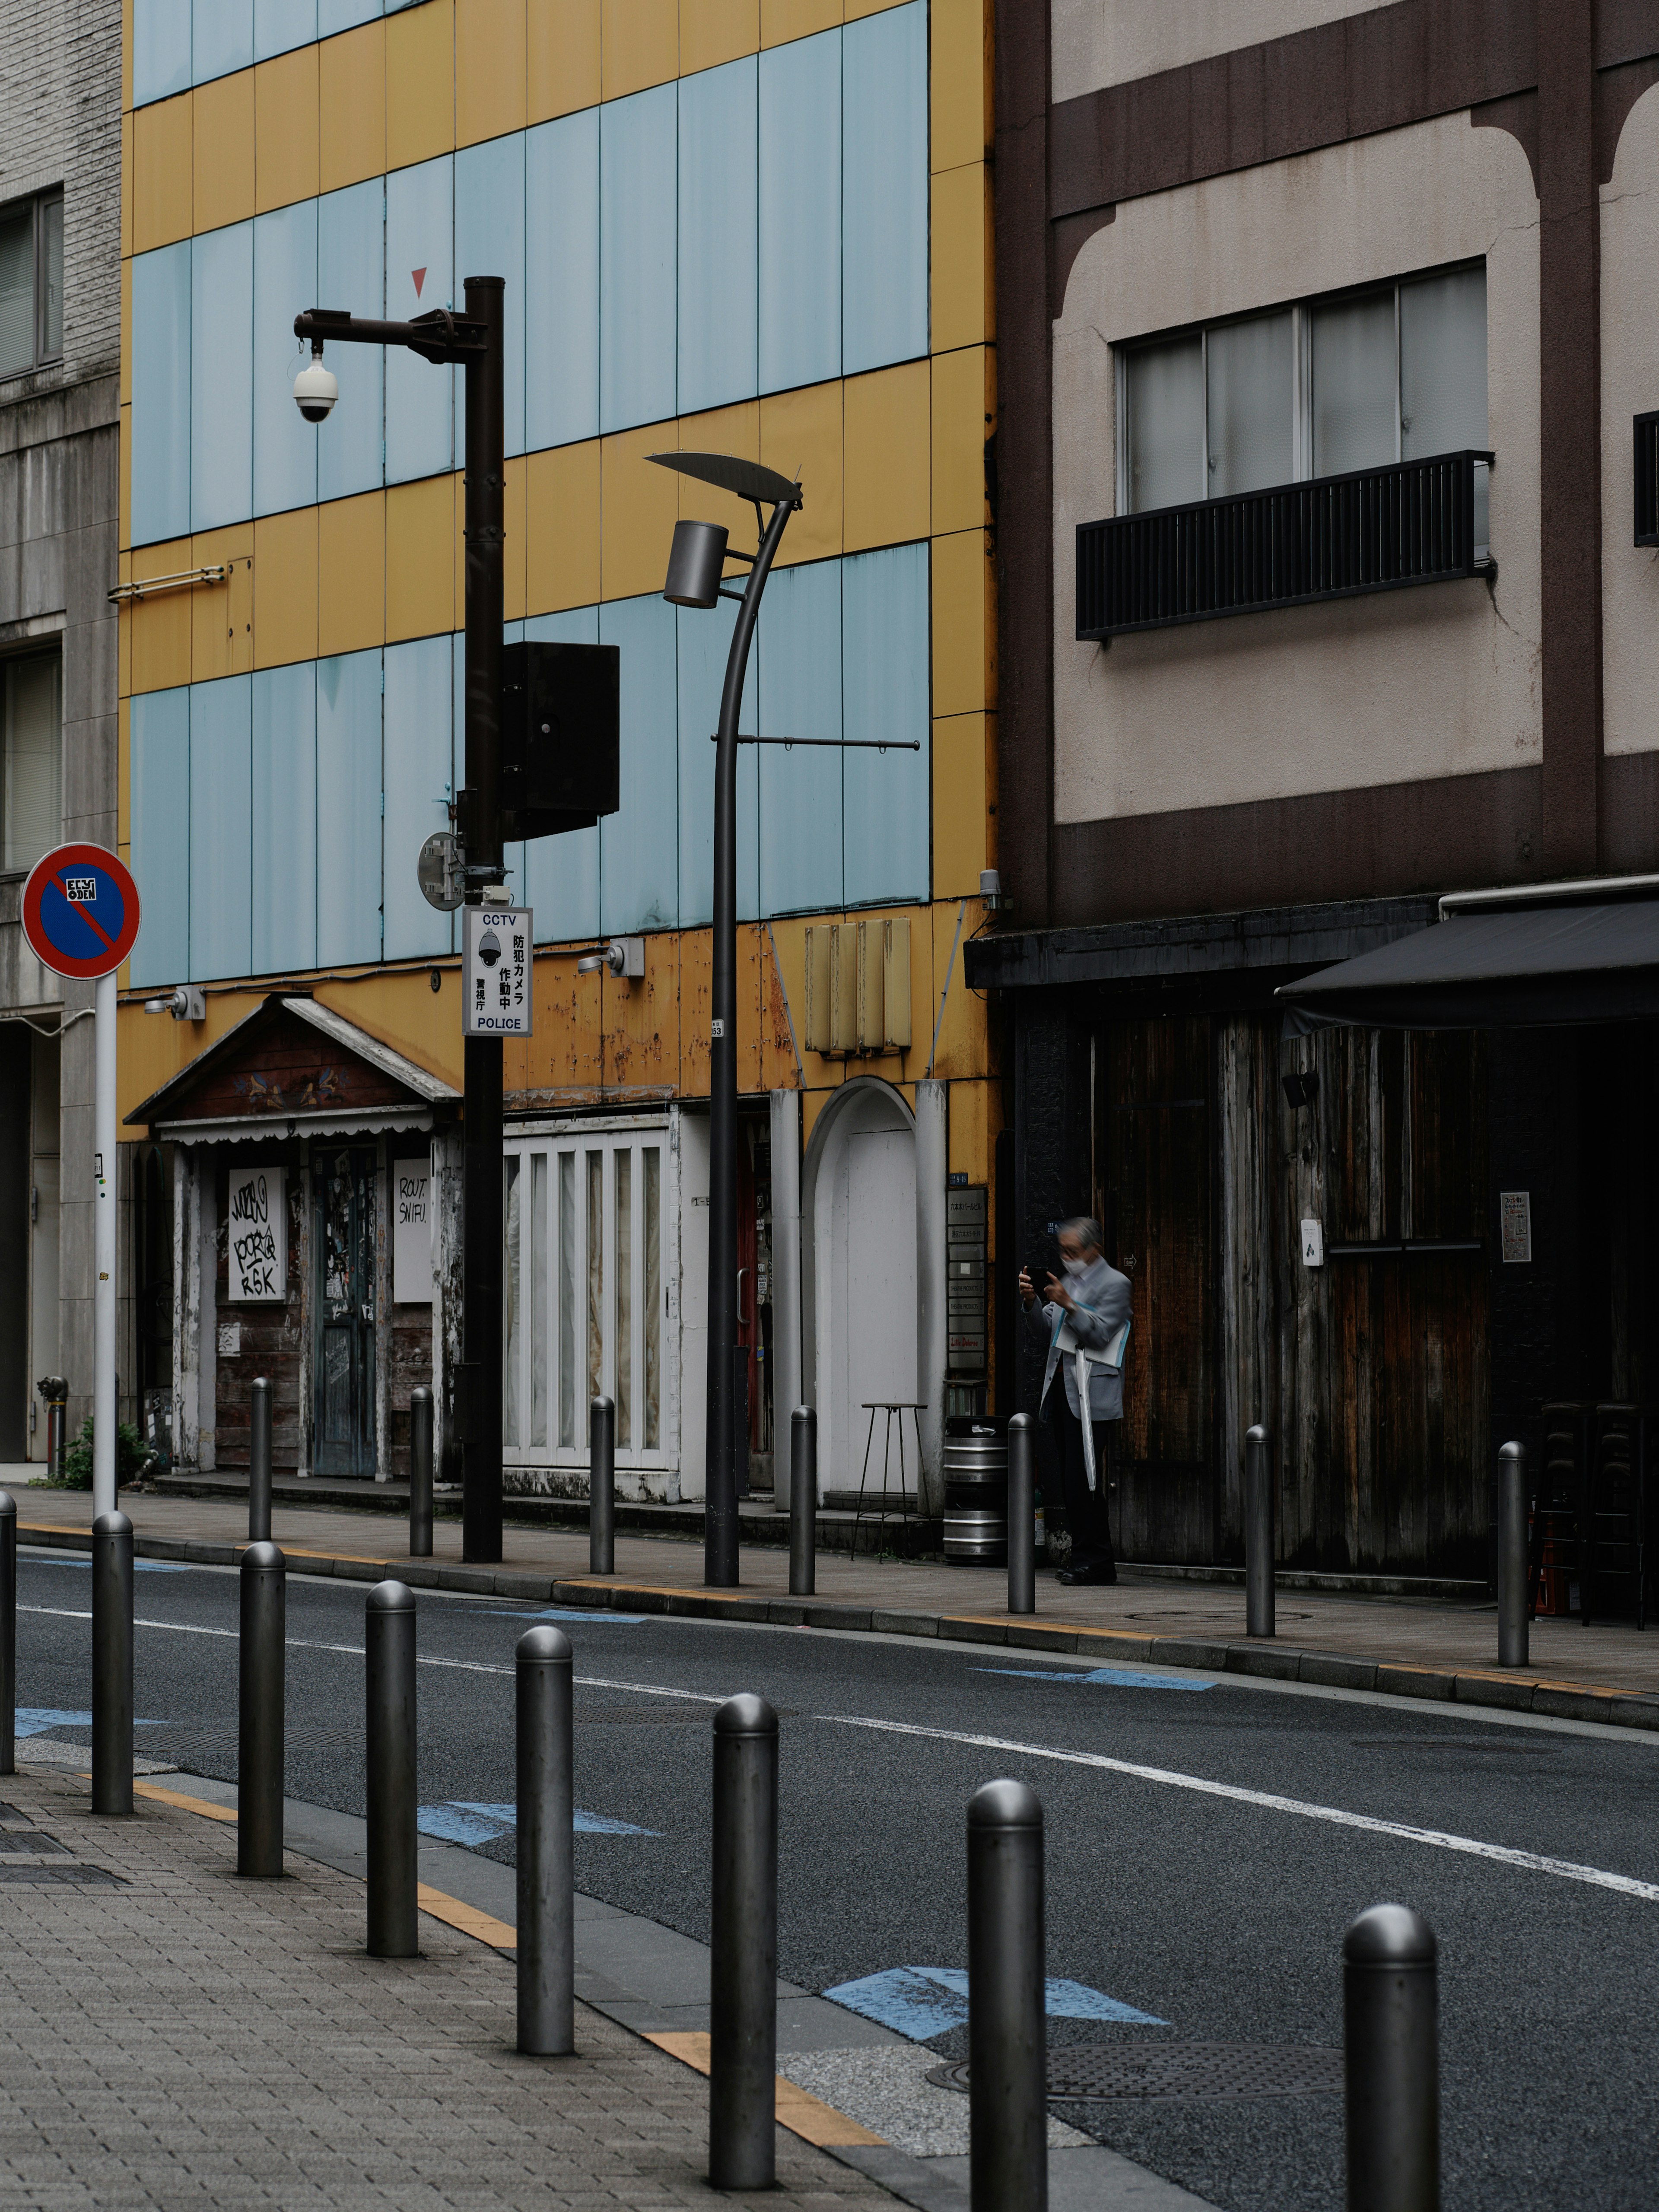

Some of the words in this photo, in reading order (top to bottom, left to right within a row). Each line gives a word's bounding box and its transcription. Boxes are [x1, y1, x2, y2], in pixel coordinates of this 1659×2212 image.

[483, 915, 517, 926] CCTV
[513, 935, 524, 1005] 防犯カメラ
[476, 979, 485, 1011] 警視庁
[499, 968, 511, 1010] 作動中
[478, 1017, 521, 1029] POLICE
